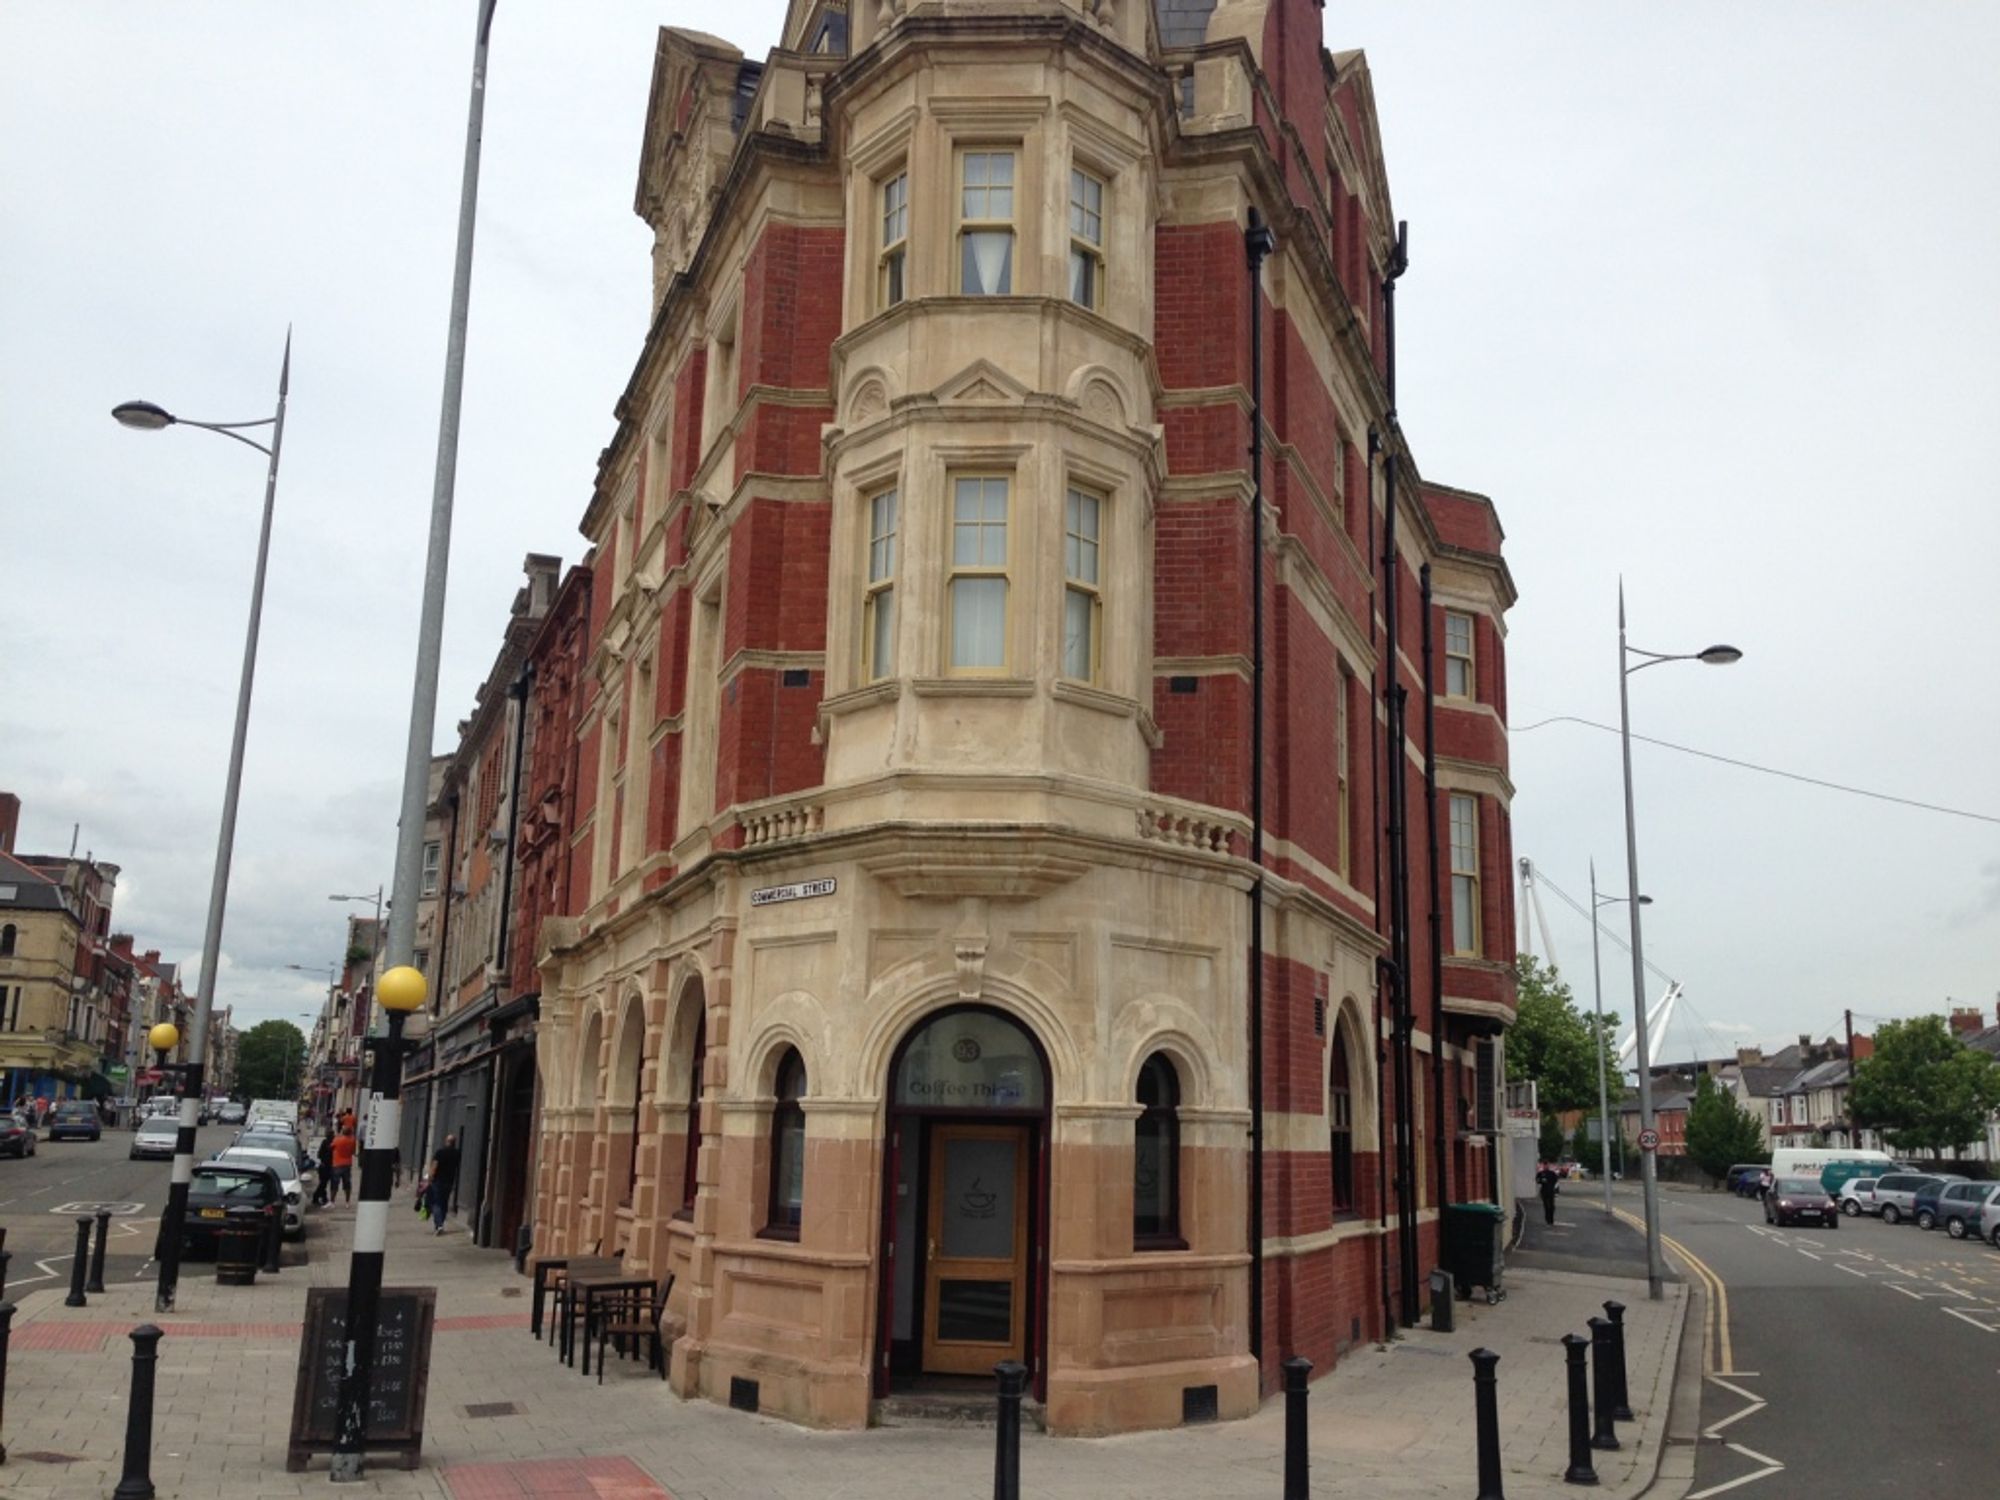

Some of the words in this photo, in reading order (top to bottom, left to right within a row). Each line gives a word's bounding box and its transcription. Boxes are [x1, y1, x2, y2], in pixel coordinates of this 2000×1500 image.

[752, 887, 797, 903] COMMERCIAL
[803, 880, 832, 897] STREET
[909, 1080, 967, 1096] Coffee
[1642, 1134, 1658, 1144] 20
